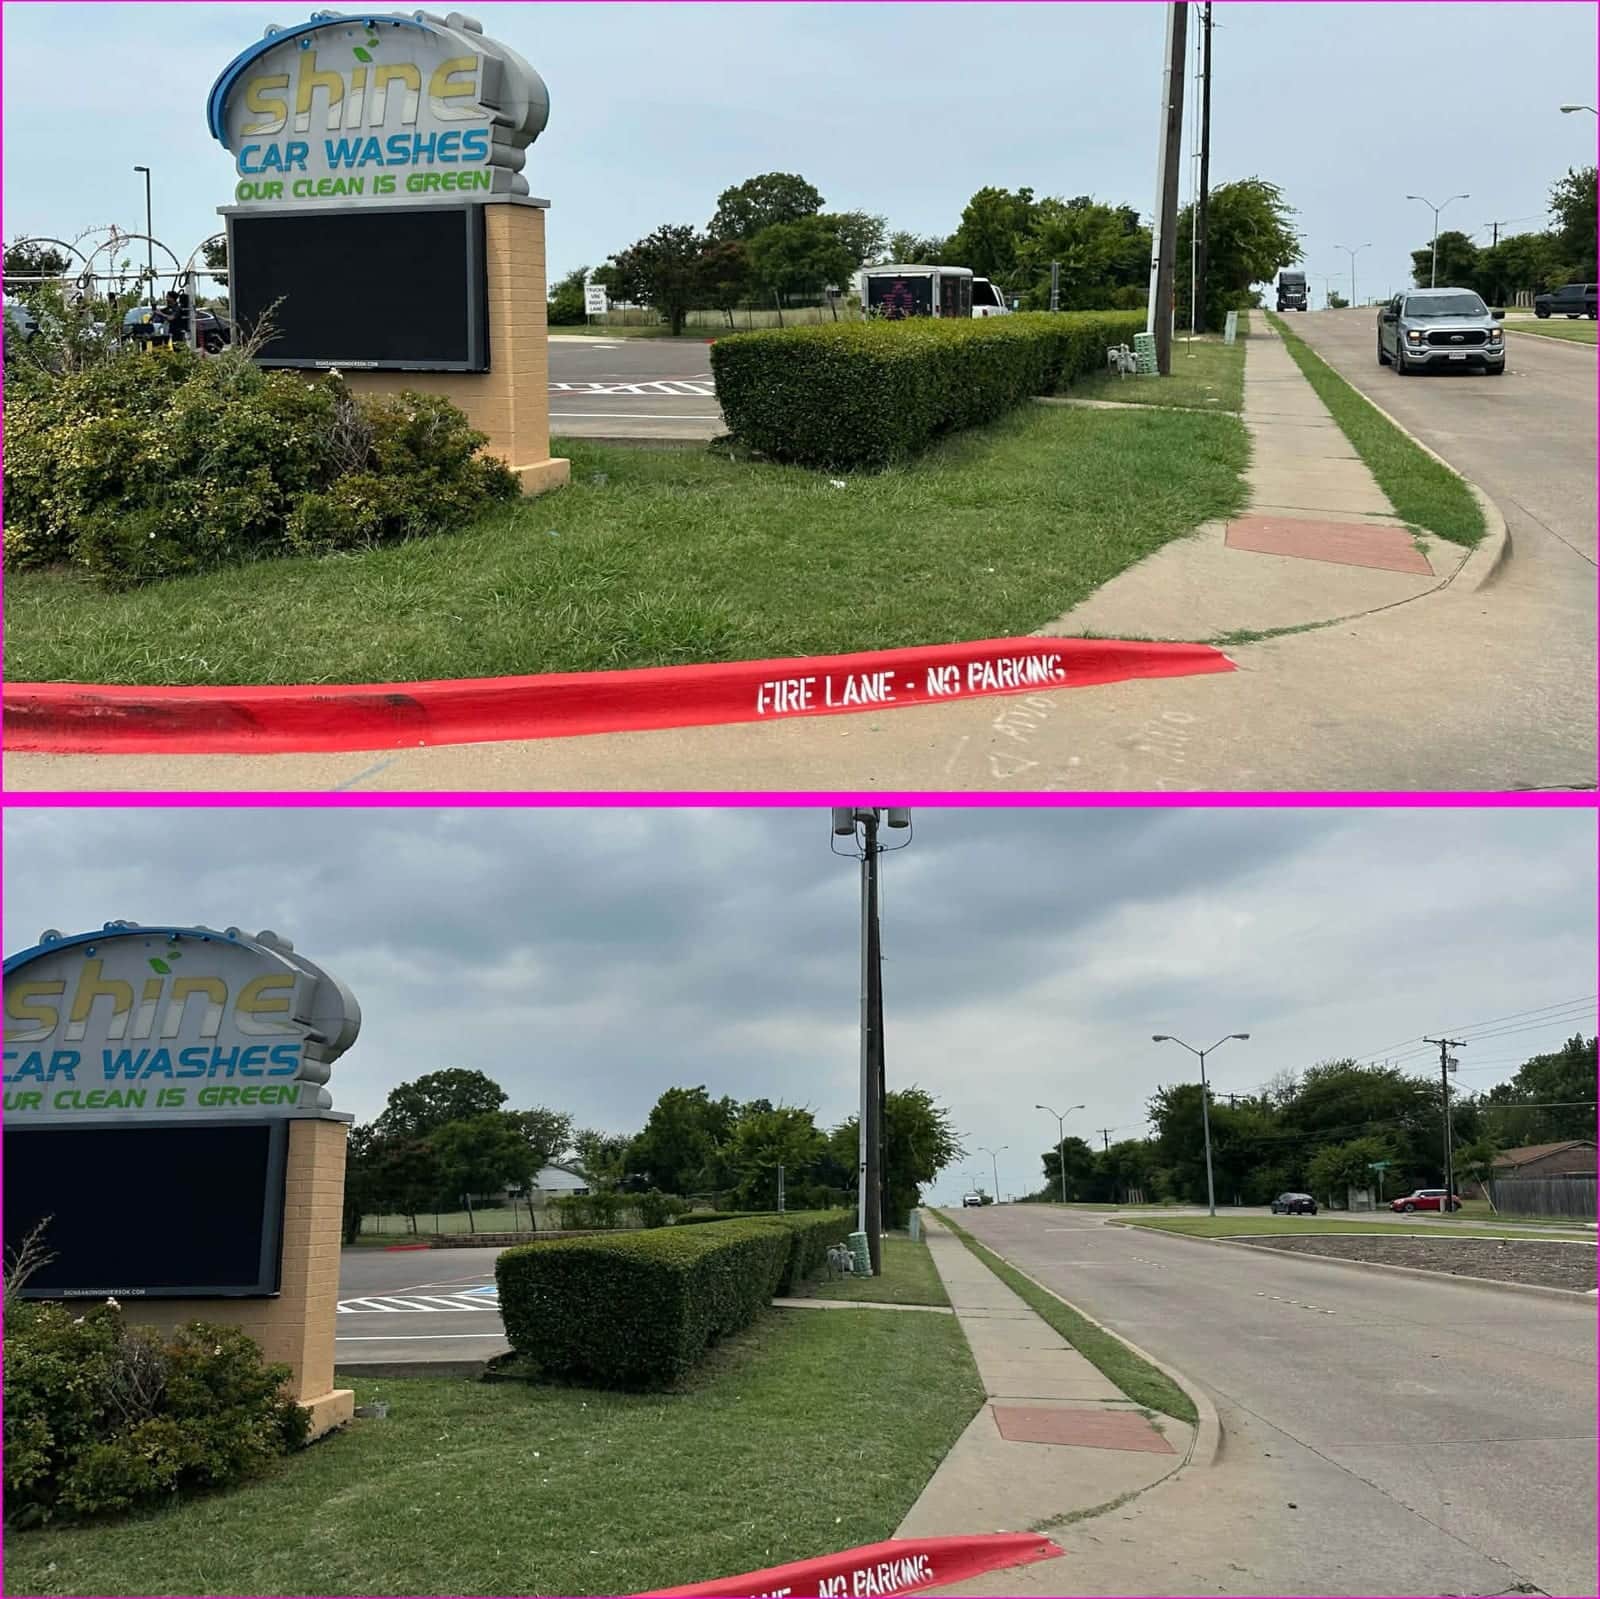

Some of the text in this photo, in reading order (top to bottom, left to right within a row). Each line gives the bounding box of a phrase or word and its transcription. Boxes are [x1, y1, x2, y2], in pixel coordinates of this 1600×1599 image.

[239, 50, 489, 137] shine
[238, 128, 489, 174] CAR WASHES
[236, 170, 491, 201] OUR CLEAN IS GREEN
[756, 677, 816, 714] FIRE
[825, 671, 896, 707] LANE
[926, 666, 961, 696] NO
[967, 654, 1066, 690] PARKING
[3, 958, 303, 1042] shine
[102, 1044, 303, 1079] WASHES
[3, 1084, 299, 1111] UR CLEAN IS GREEN
[818, 1554, 934, 1598] NO PARKING
